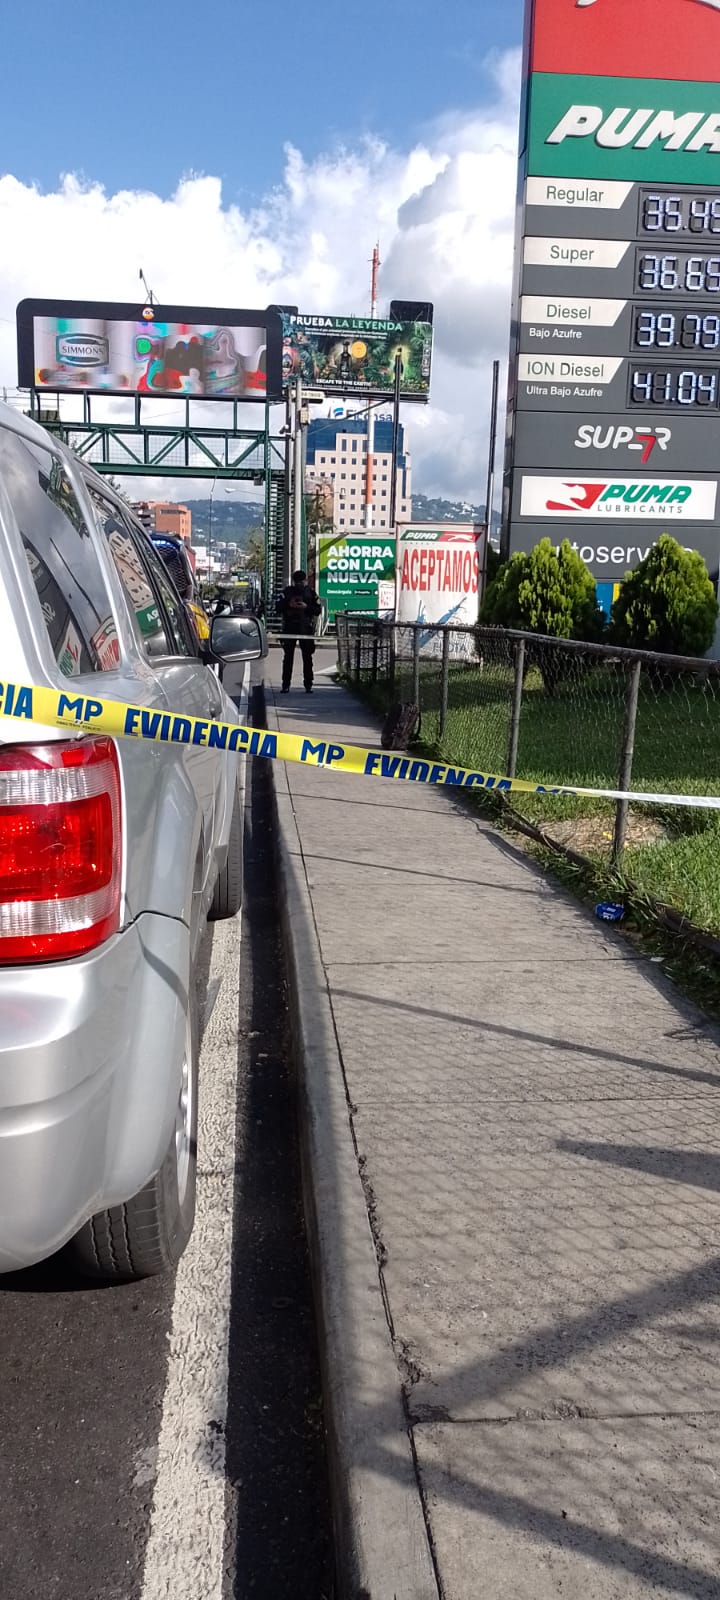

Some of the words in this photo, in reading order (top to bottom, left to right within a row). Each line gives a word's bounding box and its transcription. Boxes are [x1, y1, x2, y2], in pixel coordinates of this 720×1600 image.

[546, 185, 604, 204] Regular
[550, 245, 595, 263] Super
[546, 304, 592, 320] Diesel
[290, 315, 333, 327] PRUEBA
[336, 318, 350, 328] LA
[352, 319, 403, 331] LEYENDA
[638, 312, 720, 348] 39.79
[529, 327, 550, 339] Bajo
[552, 328, 582, 339] Azufre
[62, 345, 105, 355] SIMMONS
[527, 361, 555, 375] ION
[560, 362, 604, 377] Diesel
[526, 385, 548, 395] Ultra
[550, 386, 571, 397] Bajo
[573, 387, 603, 397] Azufre
[633, 371, 716, 404] 41.04
[599, 484, 692, 503] PUMA
[597, 504, 683, 514] LUBRICANTS
[405, 532, 438, 540] PUMA
[327, 545, 394, 558] AHORRA
[327, 558, 360, 571] CON
[364, 558, 384, 571] LA
[401, 548, 480, 593] ACEPTAMOS
[327, 571, 378, 584] NUEVA
[57, 694, 103, 721] MP
[124, 707, 277, 759] EVIDENCIA
[300, 739, 345, 764] MP
[364, 752, 512, 792] EVIDENCIA
